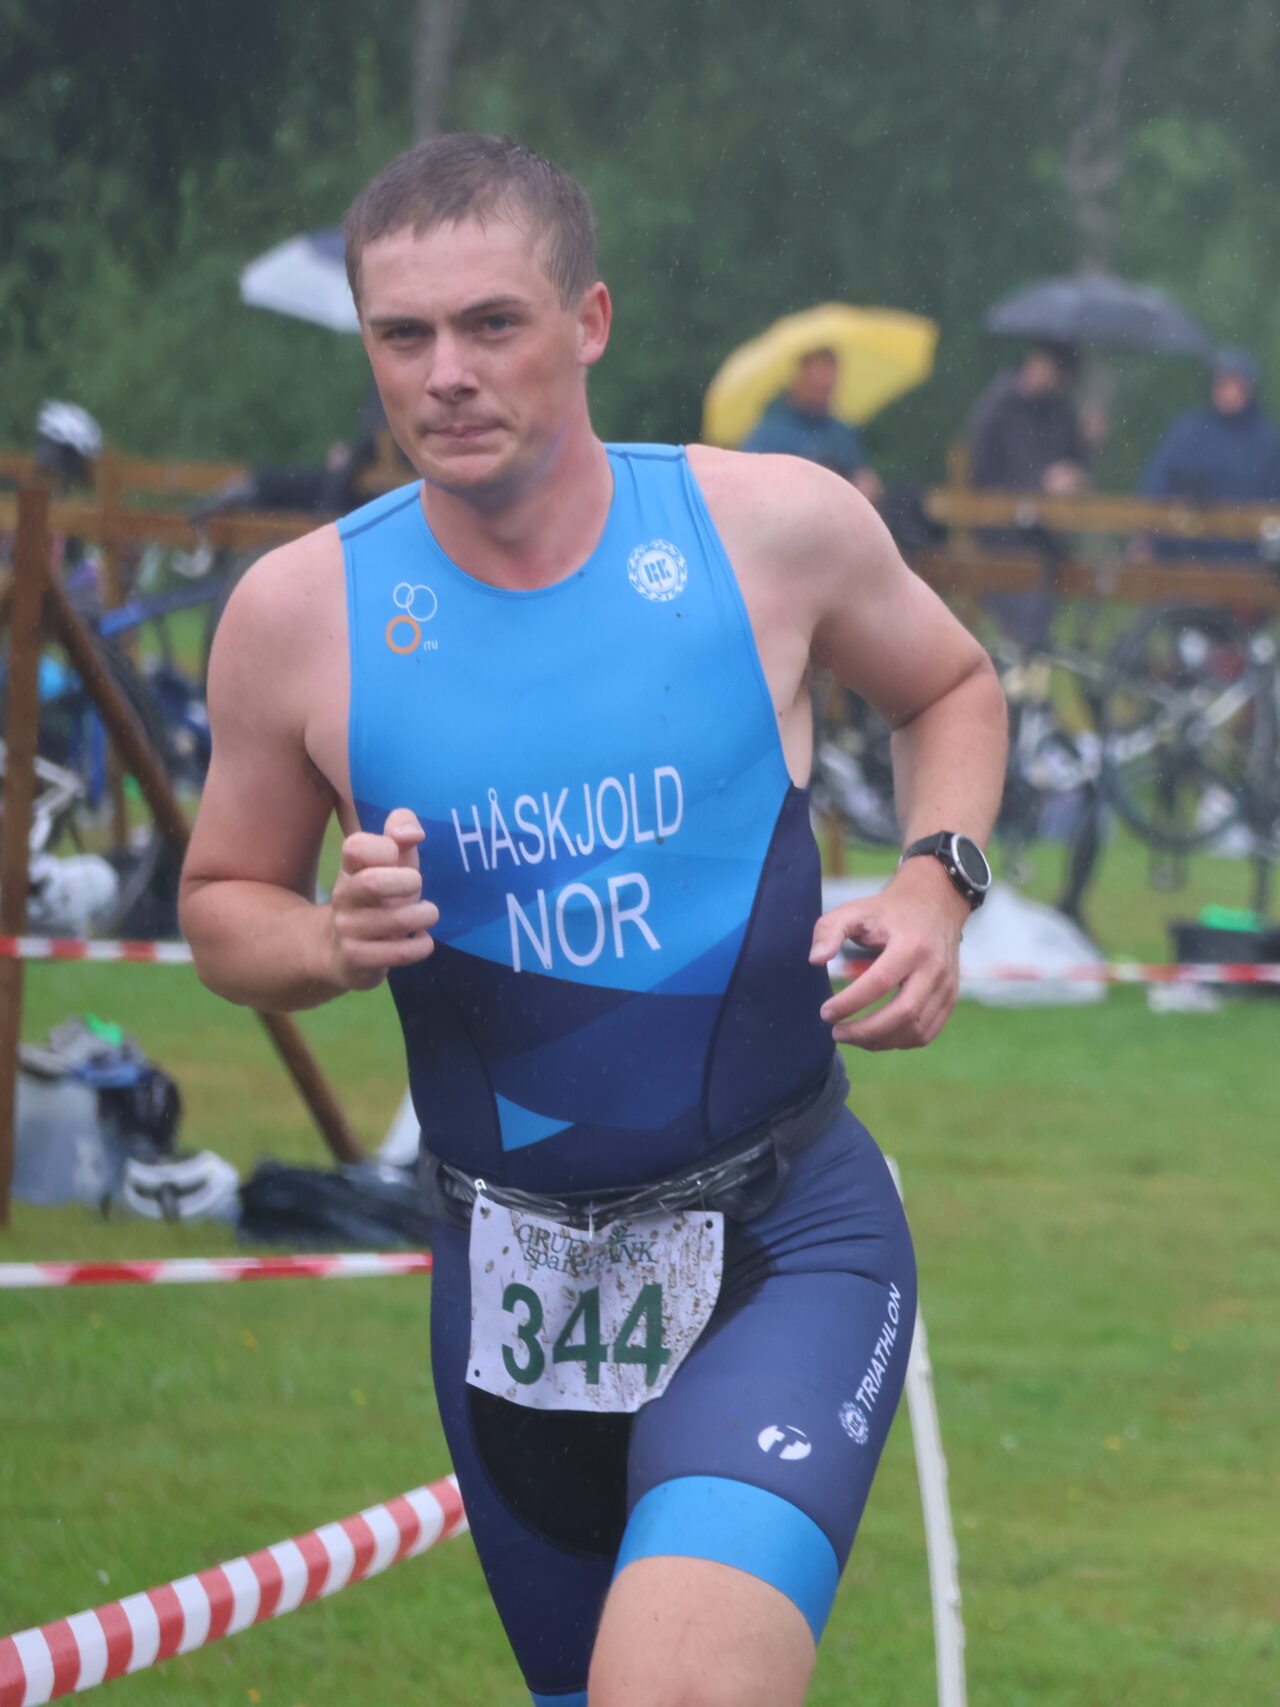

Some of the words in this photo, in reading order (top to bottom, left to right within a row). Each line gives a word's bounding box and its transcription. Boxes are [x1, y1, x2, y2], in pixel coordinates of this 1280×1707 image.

[423, 640, 438, 651] ITU
[451, 766, 684, 873] HÅSKJOLD
[506, 872, 661, 973] NOR
[502, 1283, 671, 1387] 344
[855, 1282, 901, 1412] TRIATHLON
